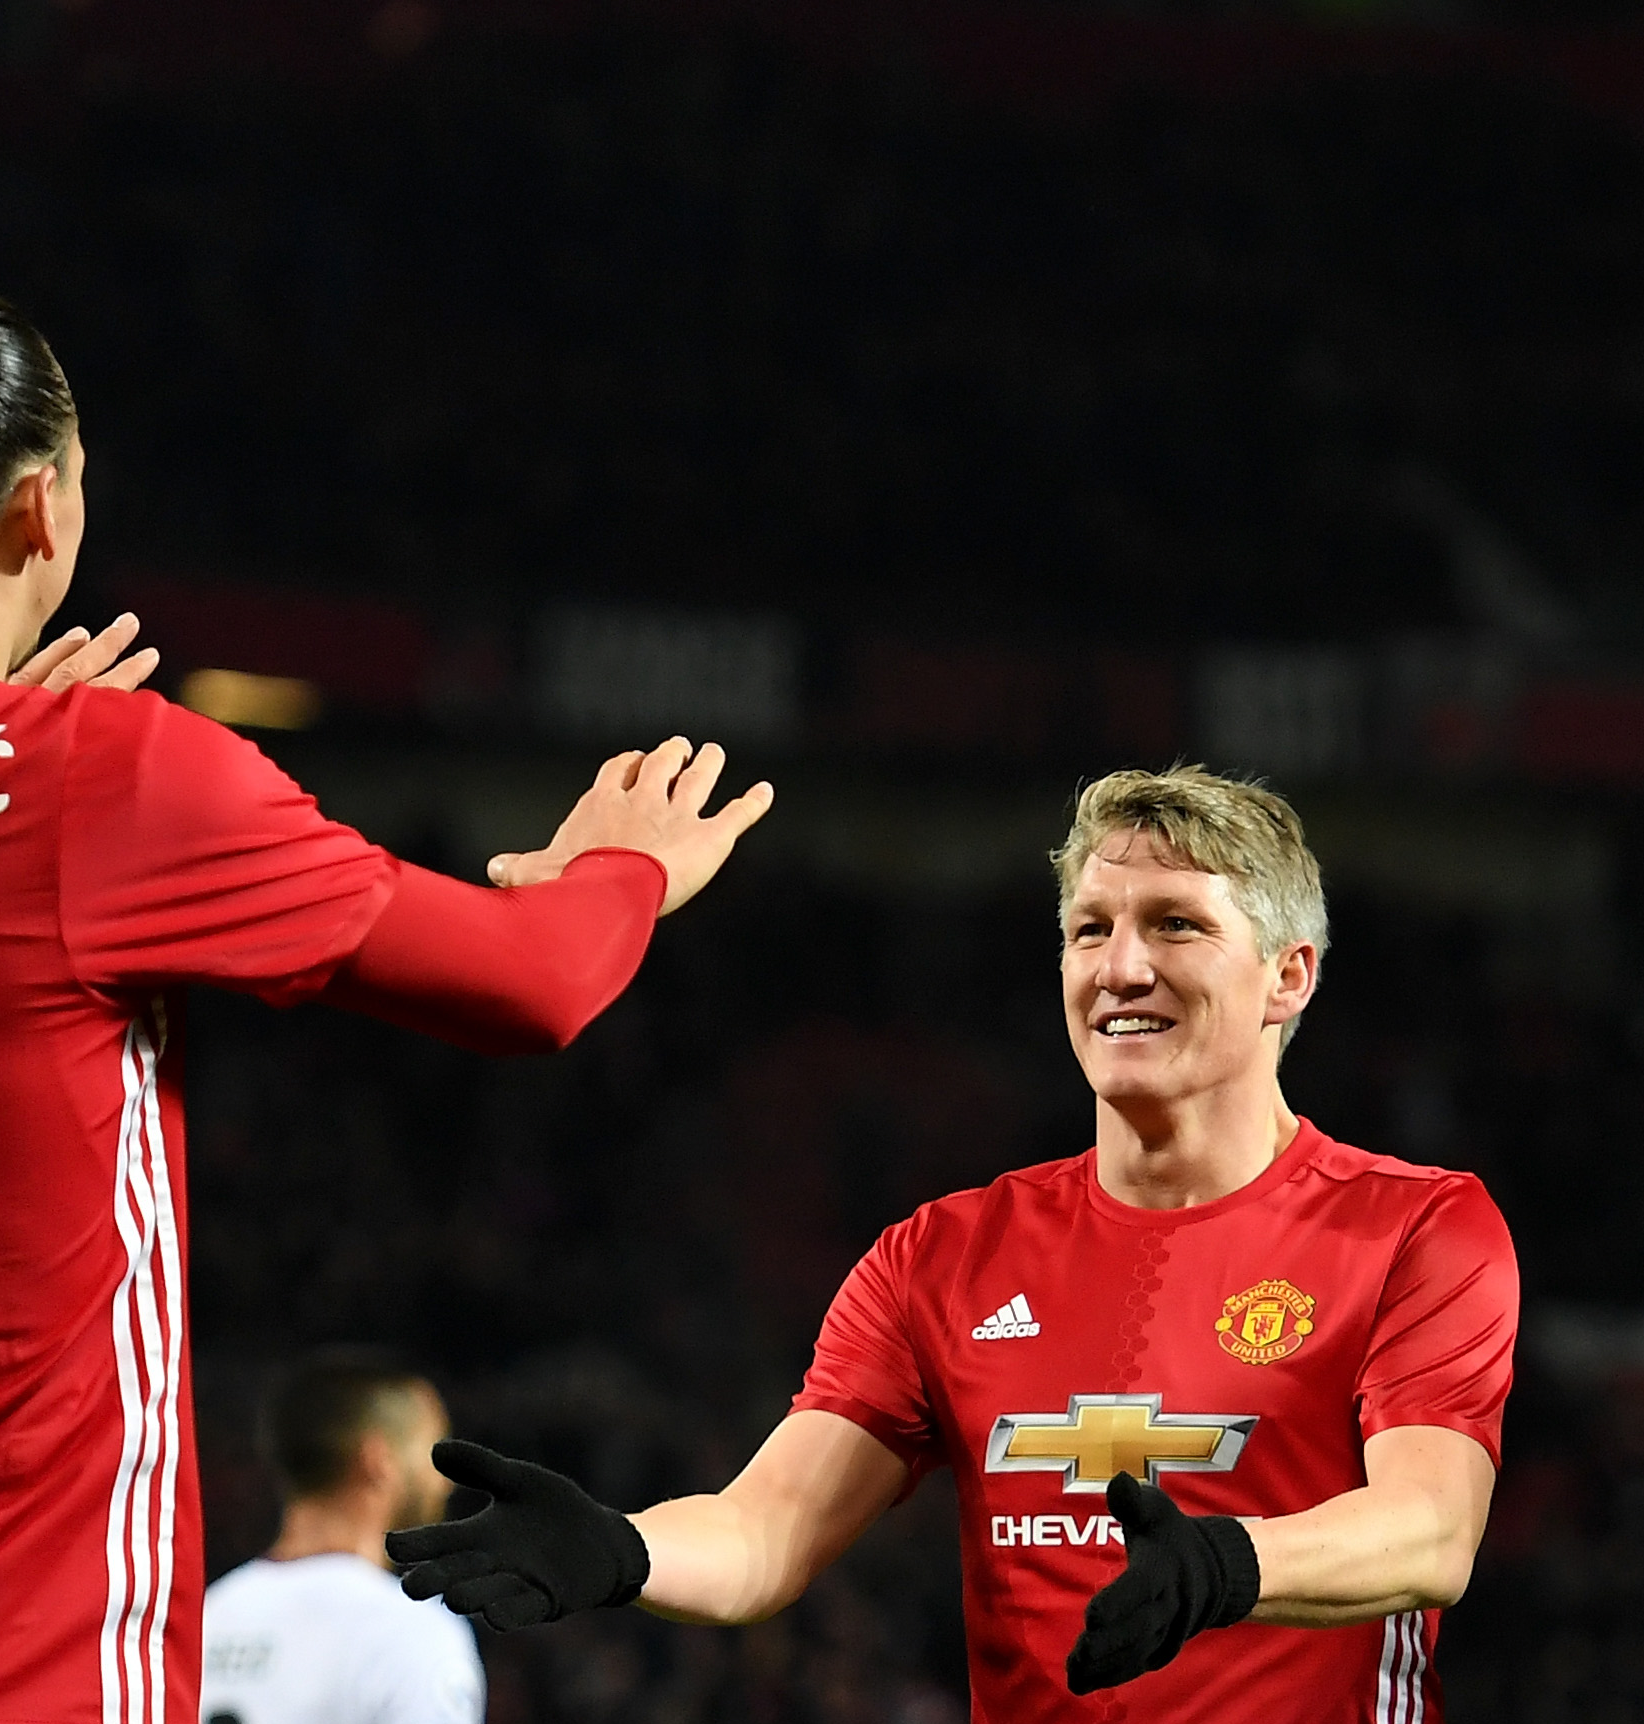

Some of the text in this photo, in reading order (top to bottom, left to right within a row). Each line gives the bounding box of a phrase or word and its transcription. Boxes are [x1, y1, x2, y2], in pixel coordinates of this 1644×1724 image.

[1230, 1286, 1307, 1315] MANCHESTER
[971, 1322, 1041, 1340] adidas
[1231, 1341, 1286, 1358] UNITED
[991, 1515, 1126, 1547] CHEVR
